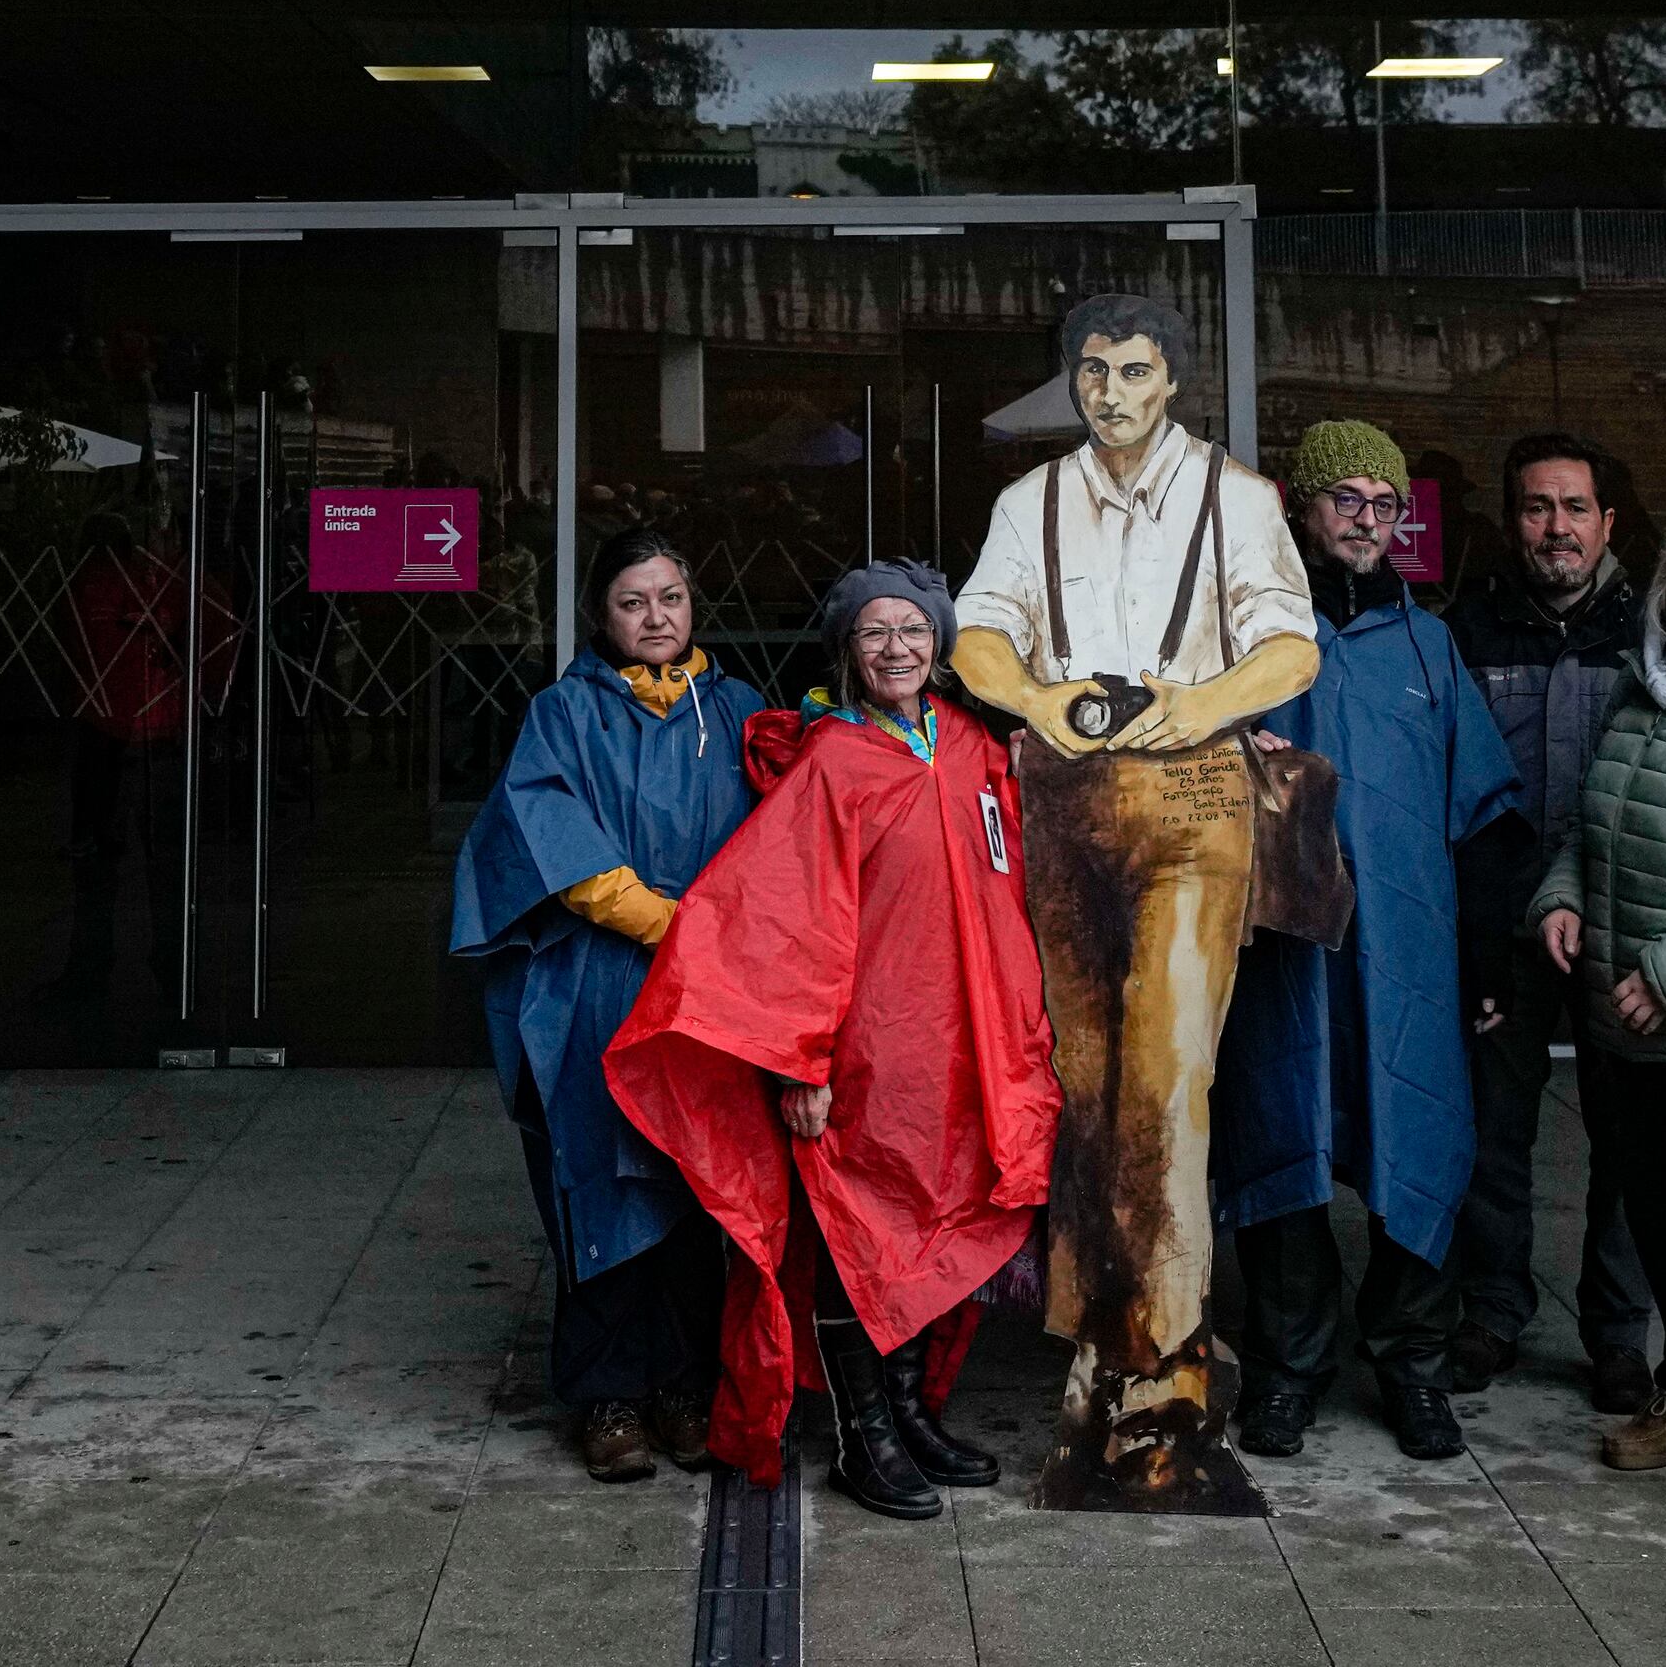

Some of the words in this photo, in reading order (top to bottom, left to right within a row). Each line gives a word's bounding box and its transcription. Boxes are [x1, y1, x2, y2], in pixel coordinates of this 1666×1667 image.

[324, 504, 377, 517] Entrada
[324, 518, 360, 531] única
[1160, 766, 1193, 778] Tello
[1179, 777, 1195, 788] 25
[1197, 775, 1225, 784] años
